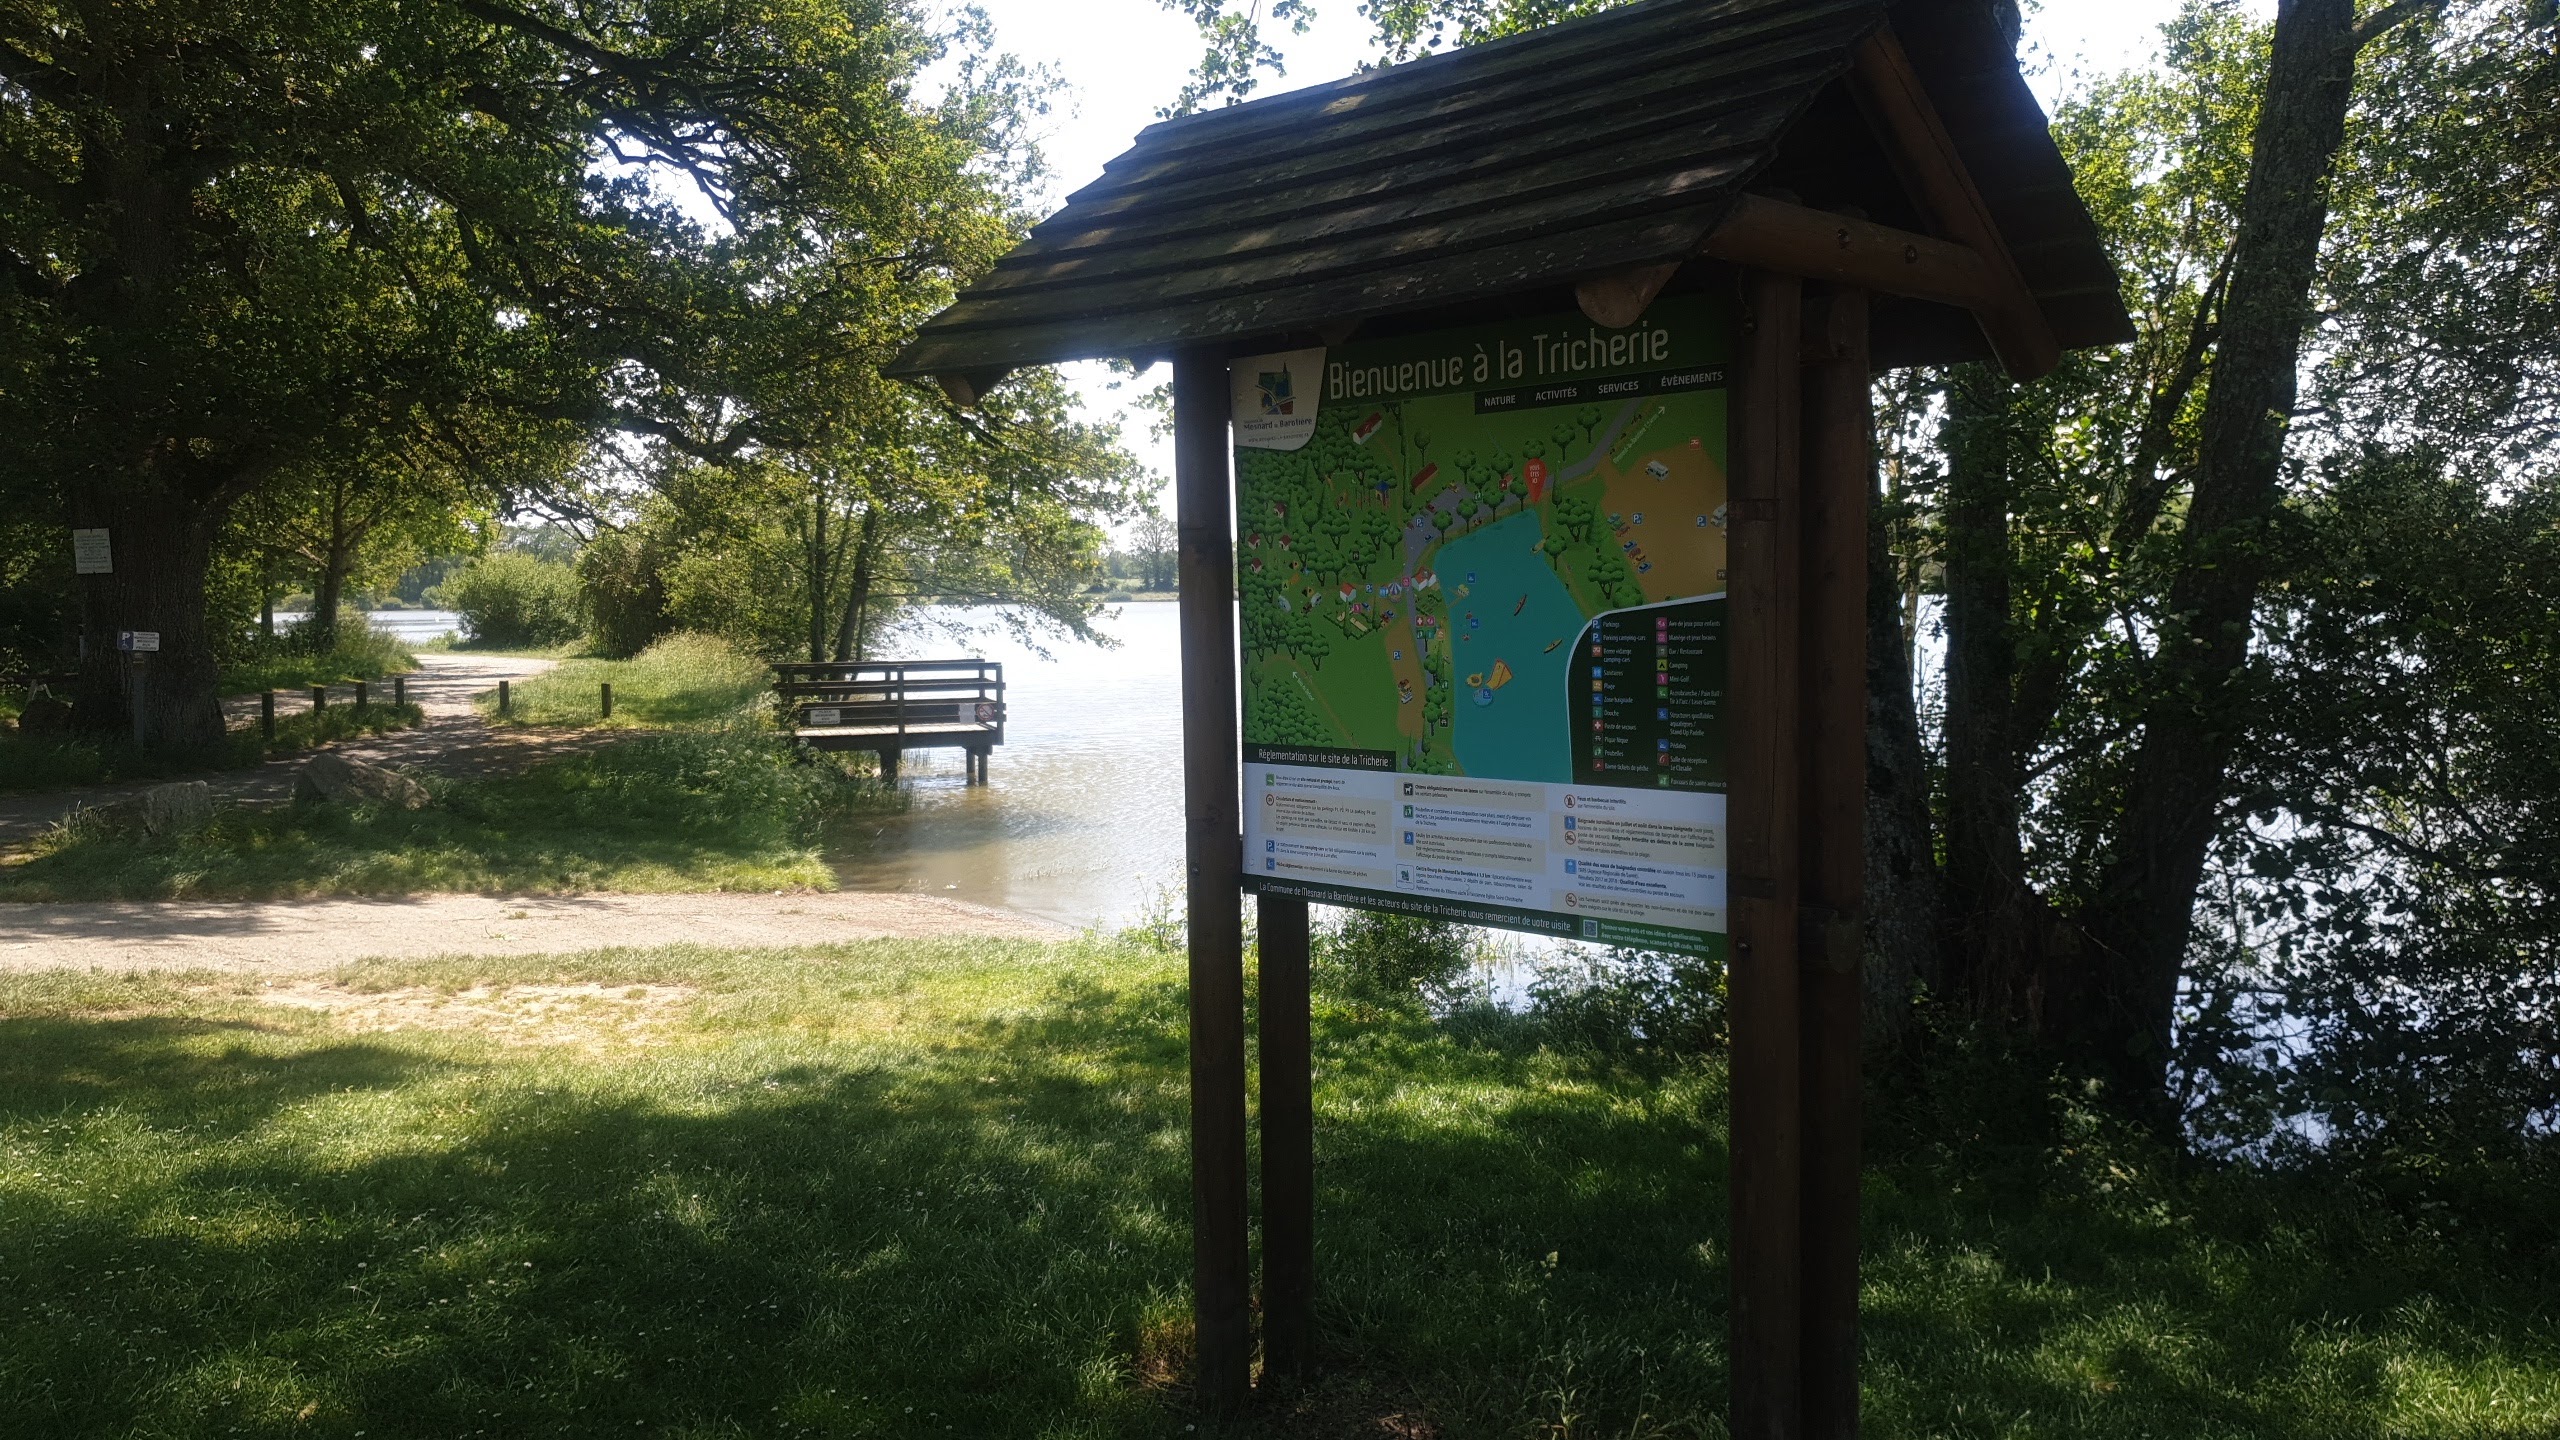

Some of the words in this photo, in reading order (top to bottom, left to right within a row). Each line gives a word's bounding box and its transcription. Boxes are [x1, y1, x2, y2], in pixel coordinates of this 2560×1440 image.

[1329, 356, 1464, 400] Bienvenue
[1473, 343, 1488, 383] à
[1499, 340, 1523, 380] la
[1533, 320, 1669, 375] Tricherie
[1484, 395, 1516, 407] NATURE
[1535, 387, 1578, 401] ACTIVITÉS
[1598, 381, 1639, 395] SERVICES
[1661, 371, 1723, 387] ÉVÈNEMENTS
[1603, 634, 1618, 642] Parking
[1308, 754, 1319, 762] sur
[1320, 752, 1326, 762] le
[1327, 753, 1340, 763] site
[1341, 754, 1350, 764] de
[1351, 754, 1357, 765] la
[1358, 755, 1388, 767] Tricherie
[1259, 881, 1266, 891] La
[1266, 882, 1293, 895] Commune
[1293, 886, 1301, 896] de
[1301, 887, 1326, 899] Mesnard
[1333, 891, 1359, 903] Barotière
[1360, 895, 1366, 904] et
[1367, 895, 1376, 905] les
[1377, 897, 1400, 908] acteurs
[1401, 899, 1409, 909] du
[1410, 901, 1422, 911] site
[1423, 902, 1431, 912] de
[1432, 903, 1438, 913] la
[1439, 904, 1466, 917] Tricherie
[1484, 912, 1520, 924] remercient
[1521, 915, 1530, 925] de
